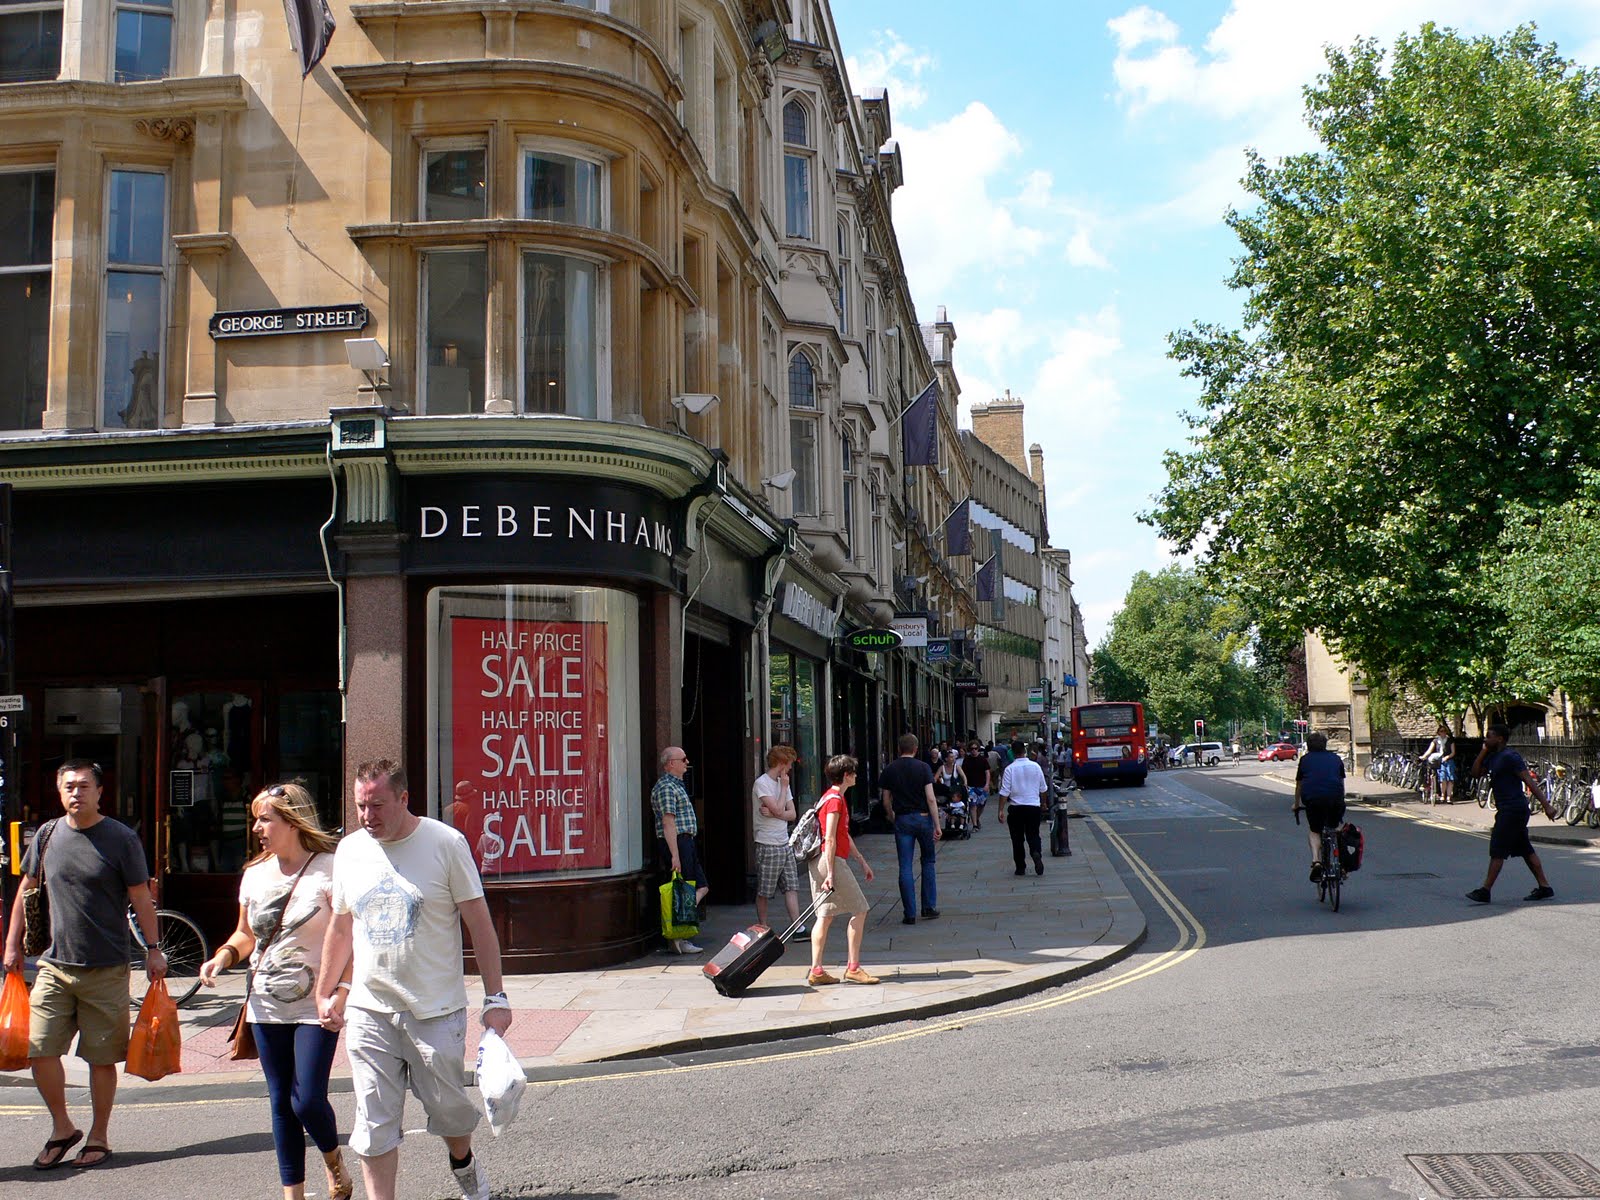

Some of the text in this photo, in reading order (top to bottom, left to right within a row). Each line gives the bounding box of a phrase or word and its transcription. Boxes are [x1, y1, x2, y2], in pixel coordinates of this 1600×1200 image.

[219, 310, 357, 332] GEORGE STREET
[420, 505, 672, 557] DEBENHAMS
[481, 630, 582, 652] HALF PRICE
[853, 633, 895, 646] schuh
[481, 654, 582, 698] SALE
[481, 710, 583, 729] HALF PRICE
[481, 734, 583, 778] SALE
[483, 788, 584, 809] HALF PRICE
[483, 812, 585, 859] SALE
